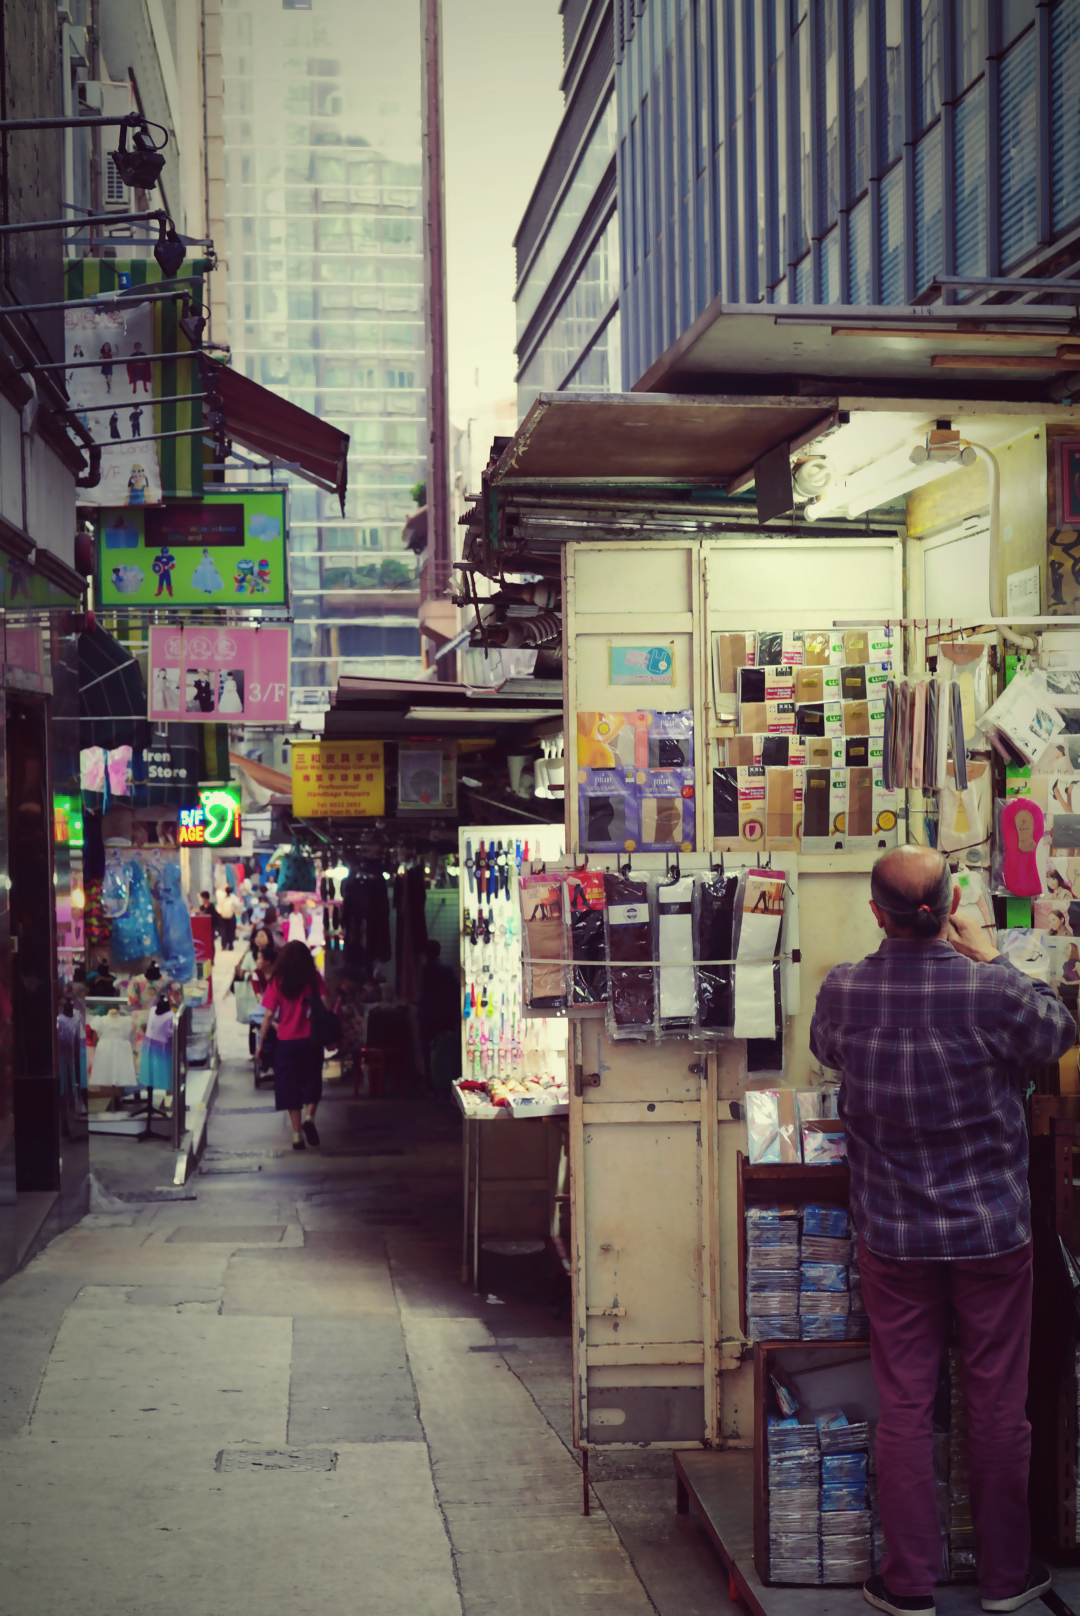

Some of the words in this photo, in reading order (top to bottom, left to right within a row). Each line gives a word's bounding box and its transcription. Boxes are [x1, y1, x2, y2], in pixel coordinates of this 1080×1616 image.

[248, 682, 286, 703] 3/F
[148, 765, 187, 779] Store
[180, 809, 204, 828] 5/F
[179, 826, 204, 842] AGE
